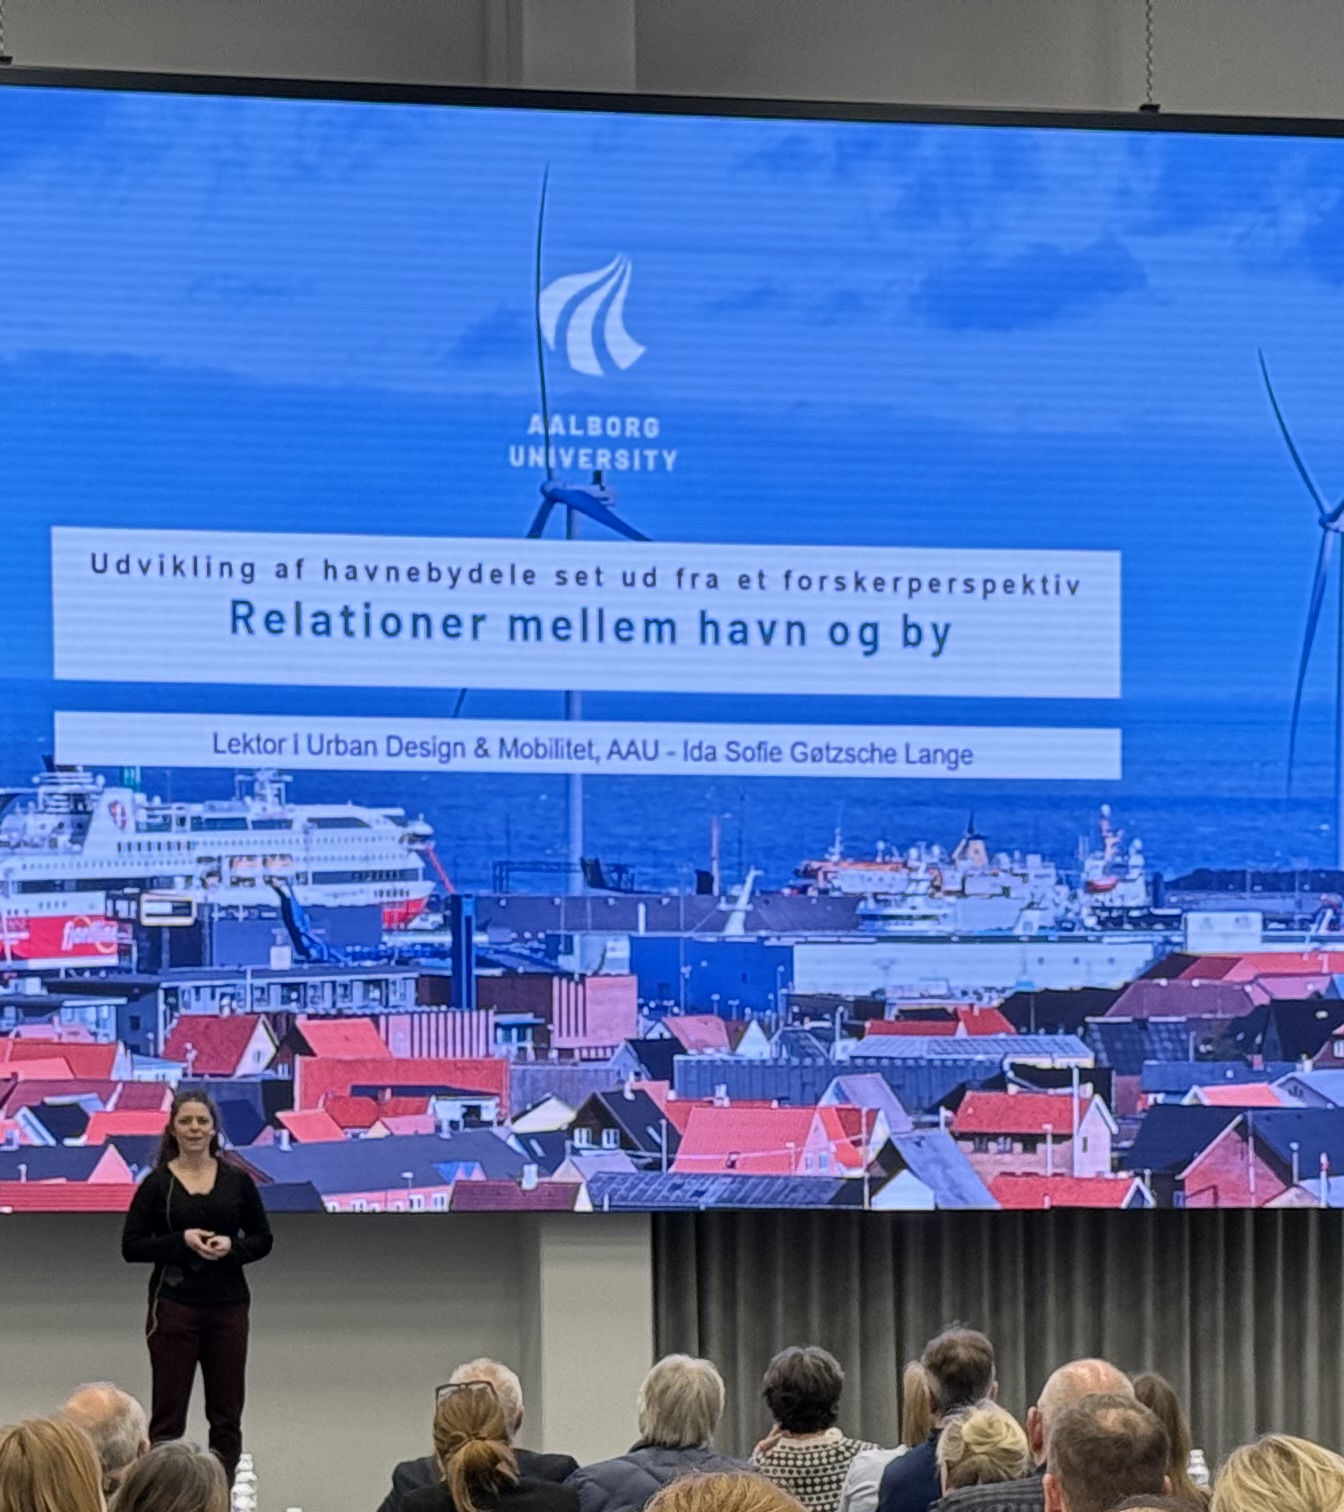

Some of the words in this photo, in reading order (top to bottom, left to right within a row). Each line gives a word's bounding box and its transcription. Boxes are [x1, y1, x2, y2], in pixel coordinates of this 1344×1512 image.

[527, 413, 659, 438] AALBORG
[509, 445, 677, 472] UNIVERSITY
[91, 552, 255, 584] Udvikling
[274, 558, 305, 580] af
[323, 559, 537, 590] havnebydele
[555, 566, 604, 587] set
[621, 566, 657, 588] ud
[676, 567, 719, 590] fra
[738, 569, 766, 591] et
[783, 569, 1081, 600] forskerperspektiv
[230, 598, 487, 641] Relationer
[508, 606, 677, 645] mellem
[699, 609, 806, 647] havn
[828, 620, 880, 657] og
[902, 613, 951, 658] by
[212, 731, 287, 756] Lektor
[307, 733, 378, 758] Urban
[386, 735, 467, 764] Design
[473, 737, 490, 760] &
[498, 738, 600, 764] Mobilitet,
[607, 739, 659, 762] AAU
[683, 740, 717, 763] Ida
[724, 741, 783, 764] Sofie
[789, 741, 897, 765] Gøtzsche
[905, 742, 975, 771] Lange
